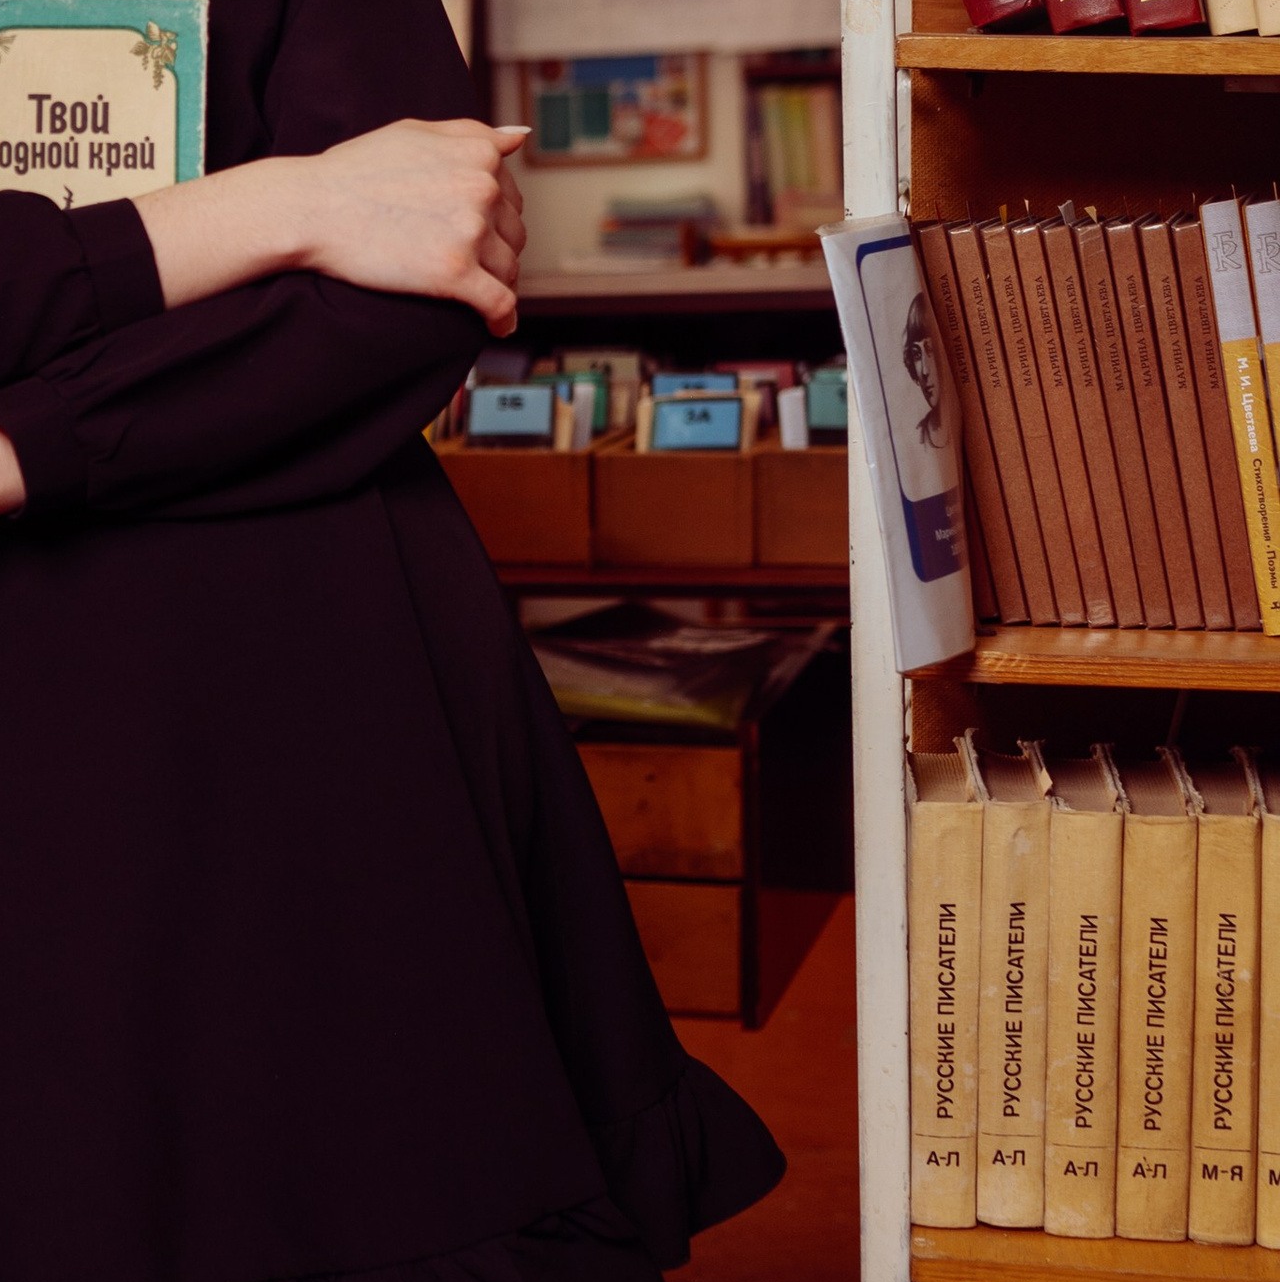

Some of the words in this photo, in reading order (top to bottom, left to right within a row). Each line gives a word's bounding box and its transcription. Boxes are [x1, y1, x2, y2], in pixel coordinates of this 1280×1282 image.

[27, 93, 111, 135] Твой
[88, 136, 156, 177] край
[941, 273, 960, 332] ЦВЕТАЕВА
[970, 276, 993, 336] ЦВЕТАЕВА
[1003, 274, 1023, 333] ЦВЕТАЕВА
[1034, 274, 1054, 335] ЦВЕТАЕВА
[1065, 274, 1085, 334] ЦВЕТАЕВА
[1097, 277, 1117, 338] ЦВЕТАЕВА
[1124, 273, 1146, 333] ЦВЕТАЕВА
[1161, 274, 1180, 336] ЦВЕТАЕВА
[1196, 274, 1212, 336] ЦВЕТАЕВА
[955, 333, 972, 385] МАРИНА
[986, 337, 1002, 389] МАРИНА
[1016, 335, 1034, 388] МАРИНА
[1047, 336, 1065, 388] МАРИНА
[1078, 335, 1095, 388] МАРИНА
[1110, 340, 1126, 392] МАРИНА
[1137, 335, 1154, 388] МАРИНА
[1174, 337, 1189, 390] МАРИНА
[1206, 337, 1221, 390] МАРИНА
[1236, 357, 1248, 372] М.
[1239, 375, 1251, 390] И.
[1240, 392, 1260, 453] Цветаева
[1250, 457, 1273, 542] Стихотворения
[1265, 550, 1280, 589] Поэмы
[940, 903, 956, 1015] ПИСАТЕЛИ
[1007, 901, 1027, 1014] ПИСАТЕЛИ
[1077, 914, 1098, 1026] ПИСАТЕЛИ
[1147, 917, 1168, 1029] ПИСАТЕЛИ
[1216, 913, 1237, 1025] ПИСАТЕЛИ
[937, 1021, 956, 1120] РУССКИЕ
[1003, 1020, 1023, 1118] РУССКИЕ
[1075, 1031, 1095, 1129] РУССКИЕ
[1144, 1035, 1165, 1131] РУССКИЕ
[1214, 1031, 1233, 1130] РУССКИЕ
[926, 1150, 960, 1168] А-Л
[992, 1148, 1026, 1167] А-Л
[1064, 1159, 1099, 1178] А-Л
[1132, 1161, 1168, 1180] А-Л
[1202, 1164, 1244, 1182] М-Я
